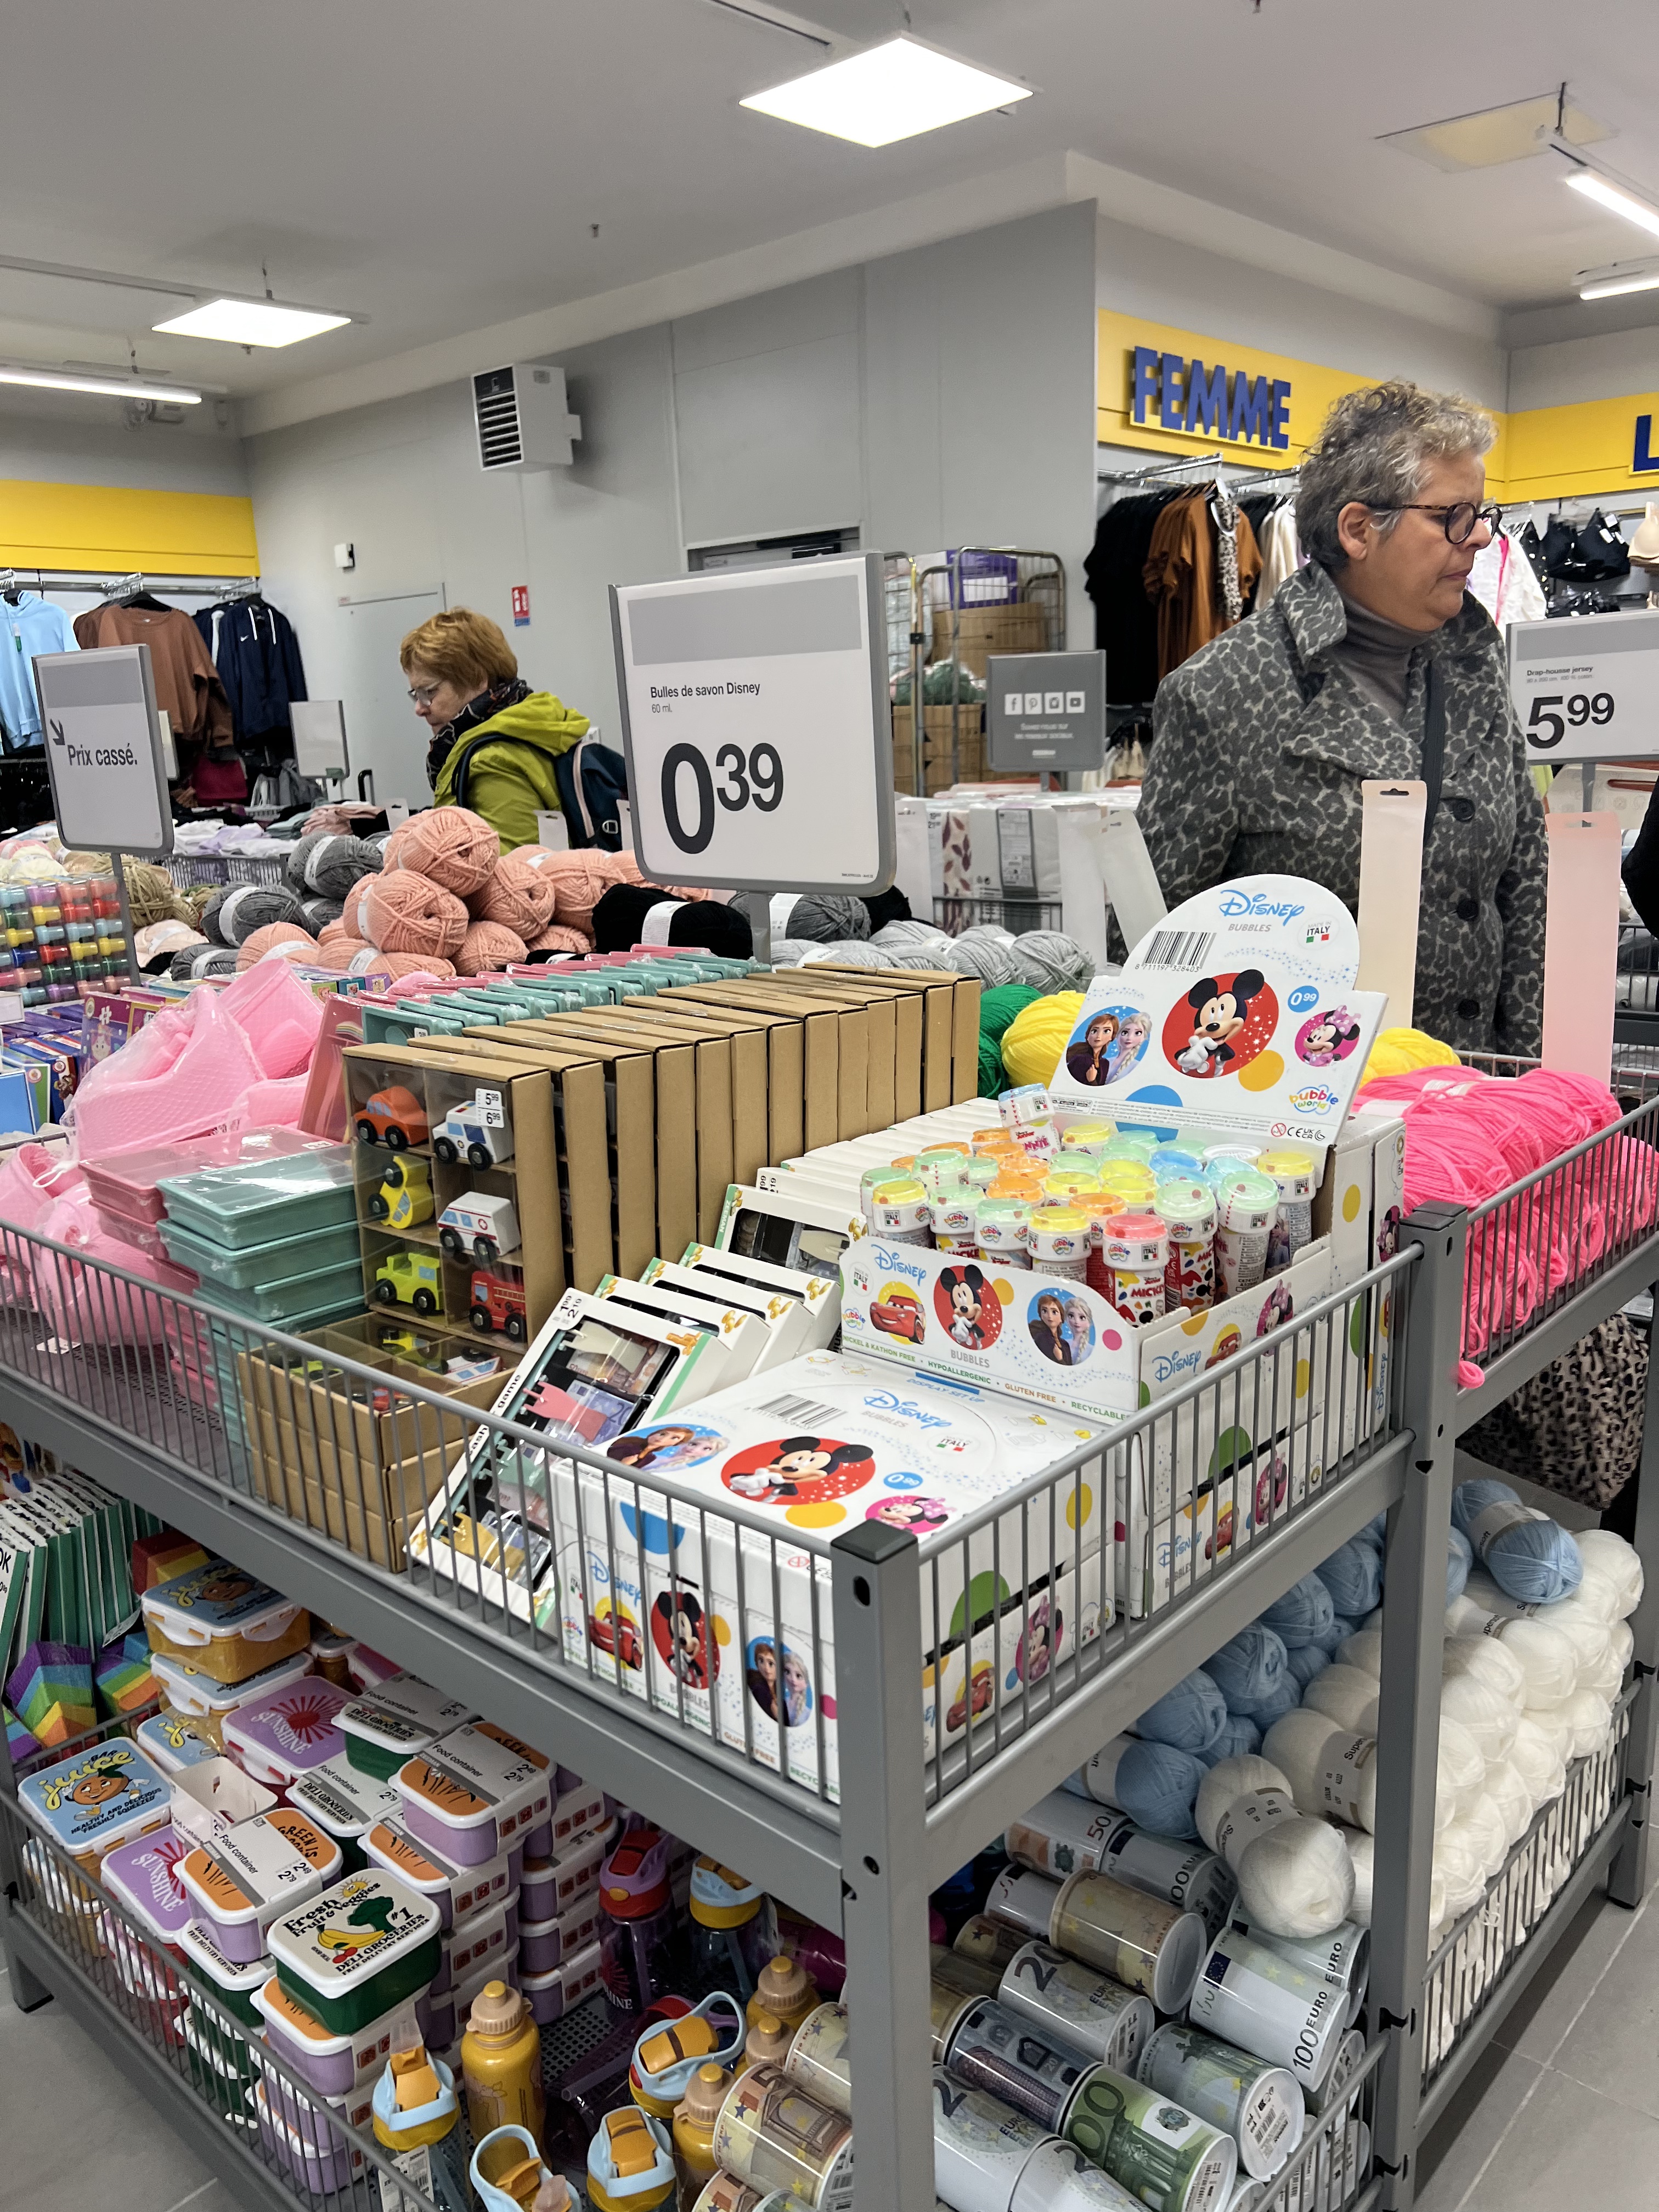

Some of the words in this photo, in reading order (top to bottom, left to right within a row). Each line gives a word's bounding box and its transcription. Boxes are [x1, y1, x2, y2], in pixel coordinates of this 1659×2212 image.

[1134, 346, 1290, 449] FEMME
[650, 686, 679, 698] Bulles
[681, 685, 693, 697] de
[695, 686, 724, 696] savon
[726, 682, 761, 696] Disney
[651, 703, 661, 713] 60
[67, 744, 93, 766] Prix
[95, 743, 138, 766] cassé.
[1228, 923, 1272, 932] BUBBLES
[1307, 926, 1331, 936] ITALY
[1289, 1090, 1339, 1105] bubble
[719, 1200, 731, 1233] ZEEMAN
[854, 1272, 868, 1284] ITALY
[950, 1349, 990, 1368] BUBBLES
[497, 1374, 521, 1409] game
[843, 1335, 864, 1346] NICKEL
[870, 1344, 898, 1357] KATHON
[899, 1352, 916, 1362] FREE
[928, 1360, 991, 1384] HYPOALLERGENIC
[1005, 1383, 1036, 1397] GLUTEN
[1036, 1392, 1057, 1403] FREE
[1071, 1401, 1130, 1421] RECYCLABLE
[906, 1378, 948, 1394] DISPLAY
[949, 1388, 967, 1399] SET
[861, 1410, 909, 1428] BUBBLES
[941, 1438, 969, 1447] ITALY
[1165, 1562, 1193, 1588] BBBLES
[365, 1690, 386, 1702] Food
[385, 1699, 419, 1716] container
[251, 1710, 312, 1754] SUNSHINE
[432, 1744, 453, 1758] Food
[449, 1756, 483, 1778] container
[38, 1752, 135, 1810] juice
[303, 1783, 323, 1796] DELI
[318, 1765, 336, 1776] Food
[332, 1774, 360, 1795] container
[71, 1813, 105, 1834] HEALTHY
[107, 1804, 123, 1815] AND
[83, 1813, 115, 1833] FRESHLY
[117, 1795, 156, 1816] SQUEEZED
[1087, 1816, 1111, 1841] 50
[219, 1834, 238, 1849] Food
[232, 1848, 258, 1874] container
[131, 1853, 184, 1912] SUNSHINE
[283, 1898, 341, 1933] Fresh
[291, 1915, 327, 1938] Fruit
[332, 1882, 381, 1911] Veggies
[335, 1951, 364, 1973] DELI
[363, 1914, 426, 1955] GROCERIES
[341, 1962, 362, 1976] FREE
[362, 1943, 396, 1964] DELIVERY
[1325, 1942, 1342, 1984] EURO
[1293, 2029, 1319, 2070] 100
[1306, 1990, 1328, 2029] EURO
